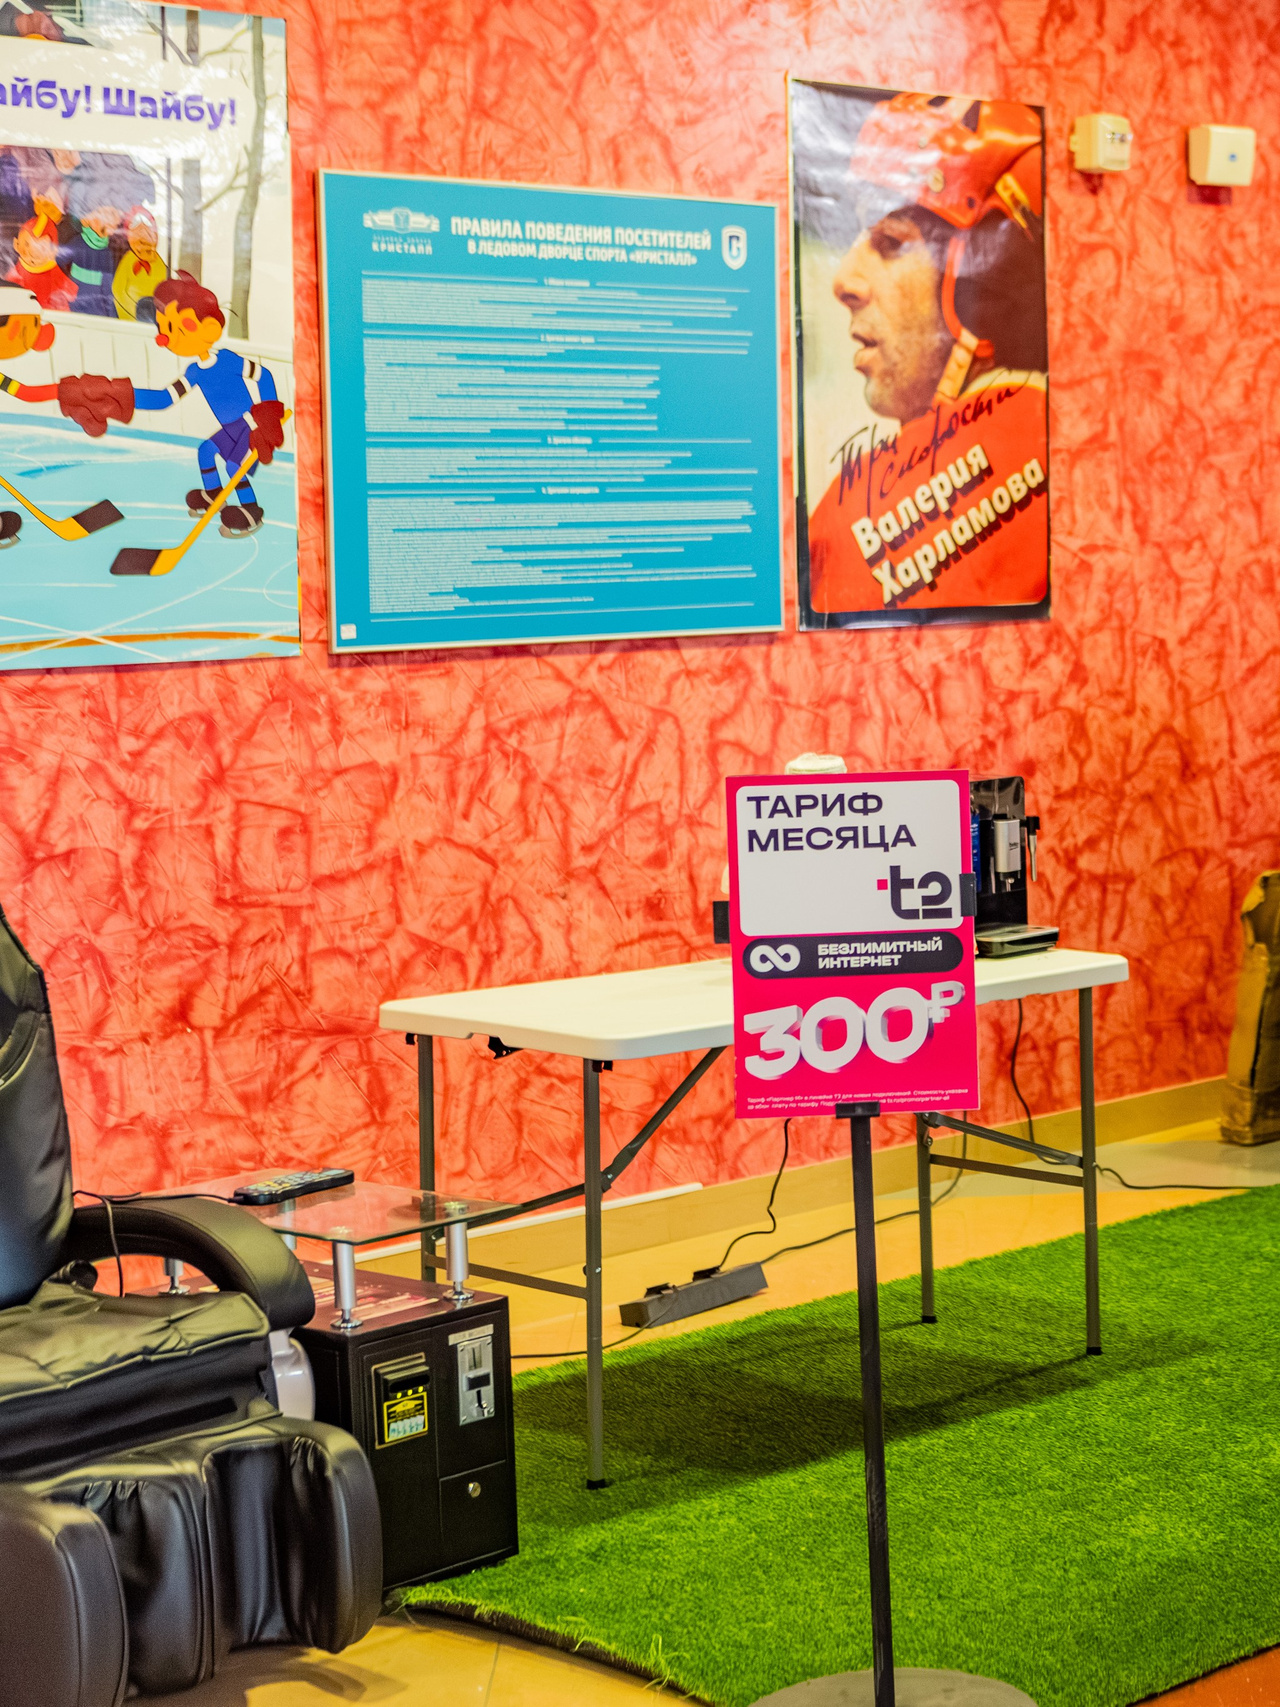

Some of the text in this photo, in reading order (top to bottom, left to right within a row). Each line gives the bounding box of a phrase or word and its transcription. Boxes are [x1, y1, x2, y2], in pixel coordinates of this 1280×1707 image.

[103, 87, 237, 130] Шайбу!
[450, 216, 711, 251] ПРАВИЛА ПОВЕДЕНИЯ ПОСЕТИТЕЛЕЙ
[467, 238, 698, 267] В ЛЕДОВОМ ДВОРЦЕ СПОРТА «КРИСТАЛЛ»
[850, 444, 992, 562] Валерия
[872, 457, 1047, 605] Харламова
[747, 792, 883, 820] ТАРИФ
[747, 824, 916, 853] МЕСЯЦА
[877, 865, 952, 920] t2
[818, 936, 943, 956] БЕЗЛИМИТНЫЙ
[818, 954, 902, 969] ИНТЕРНЕТ
